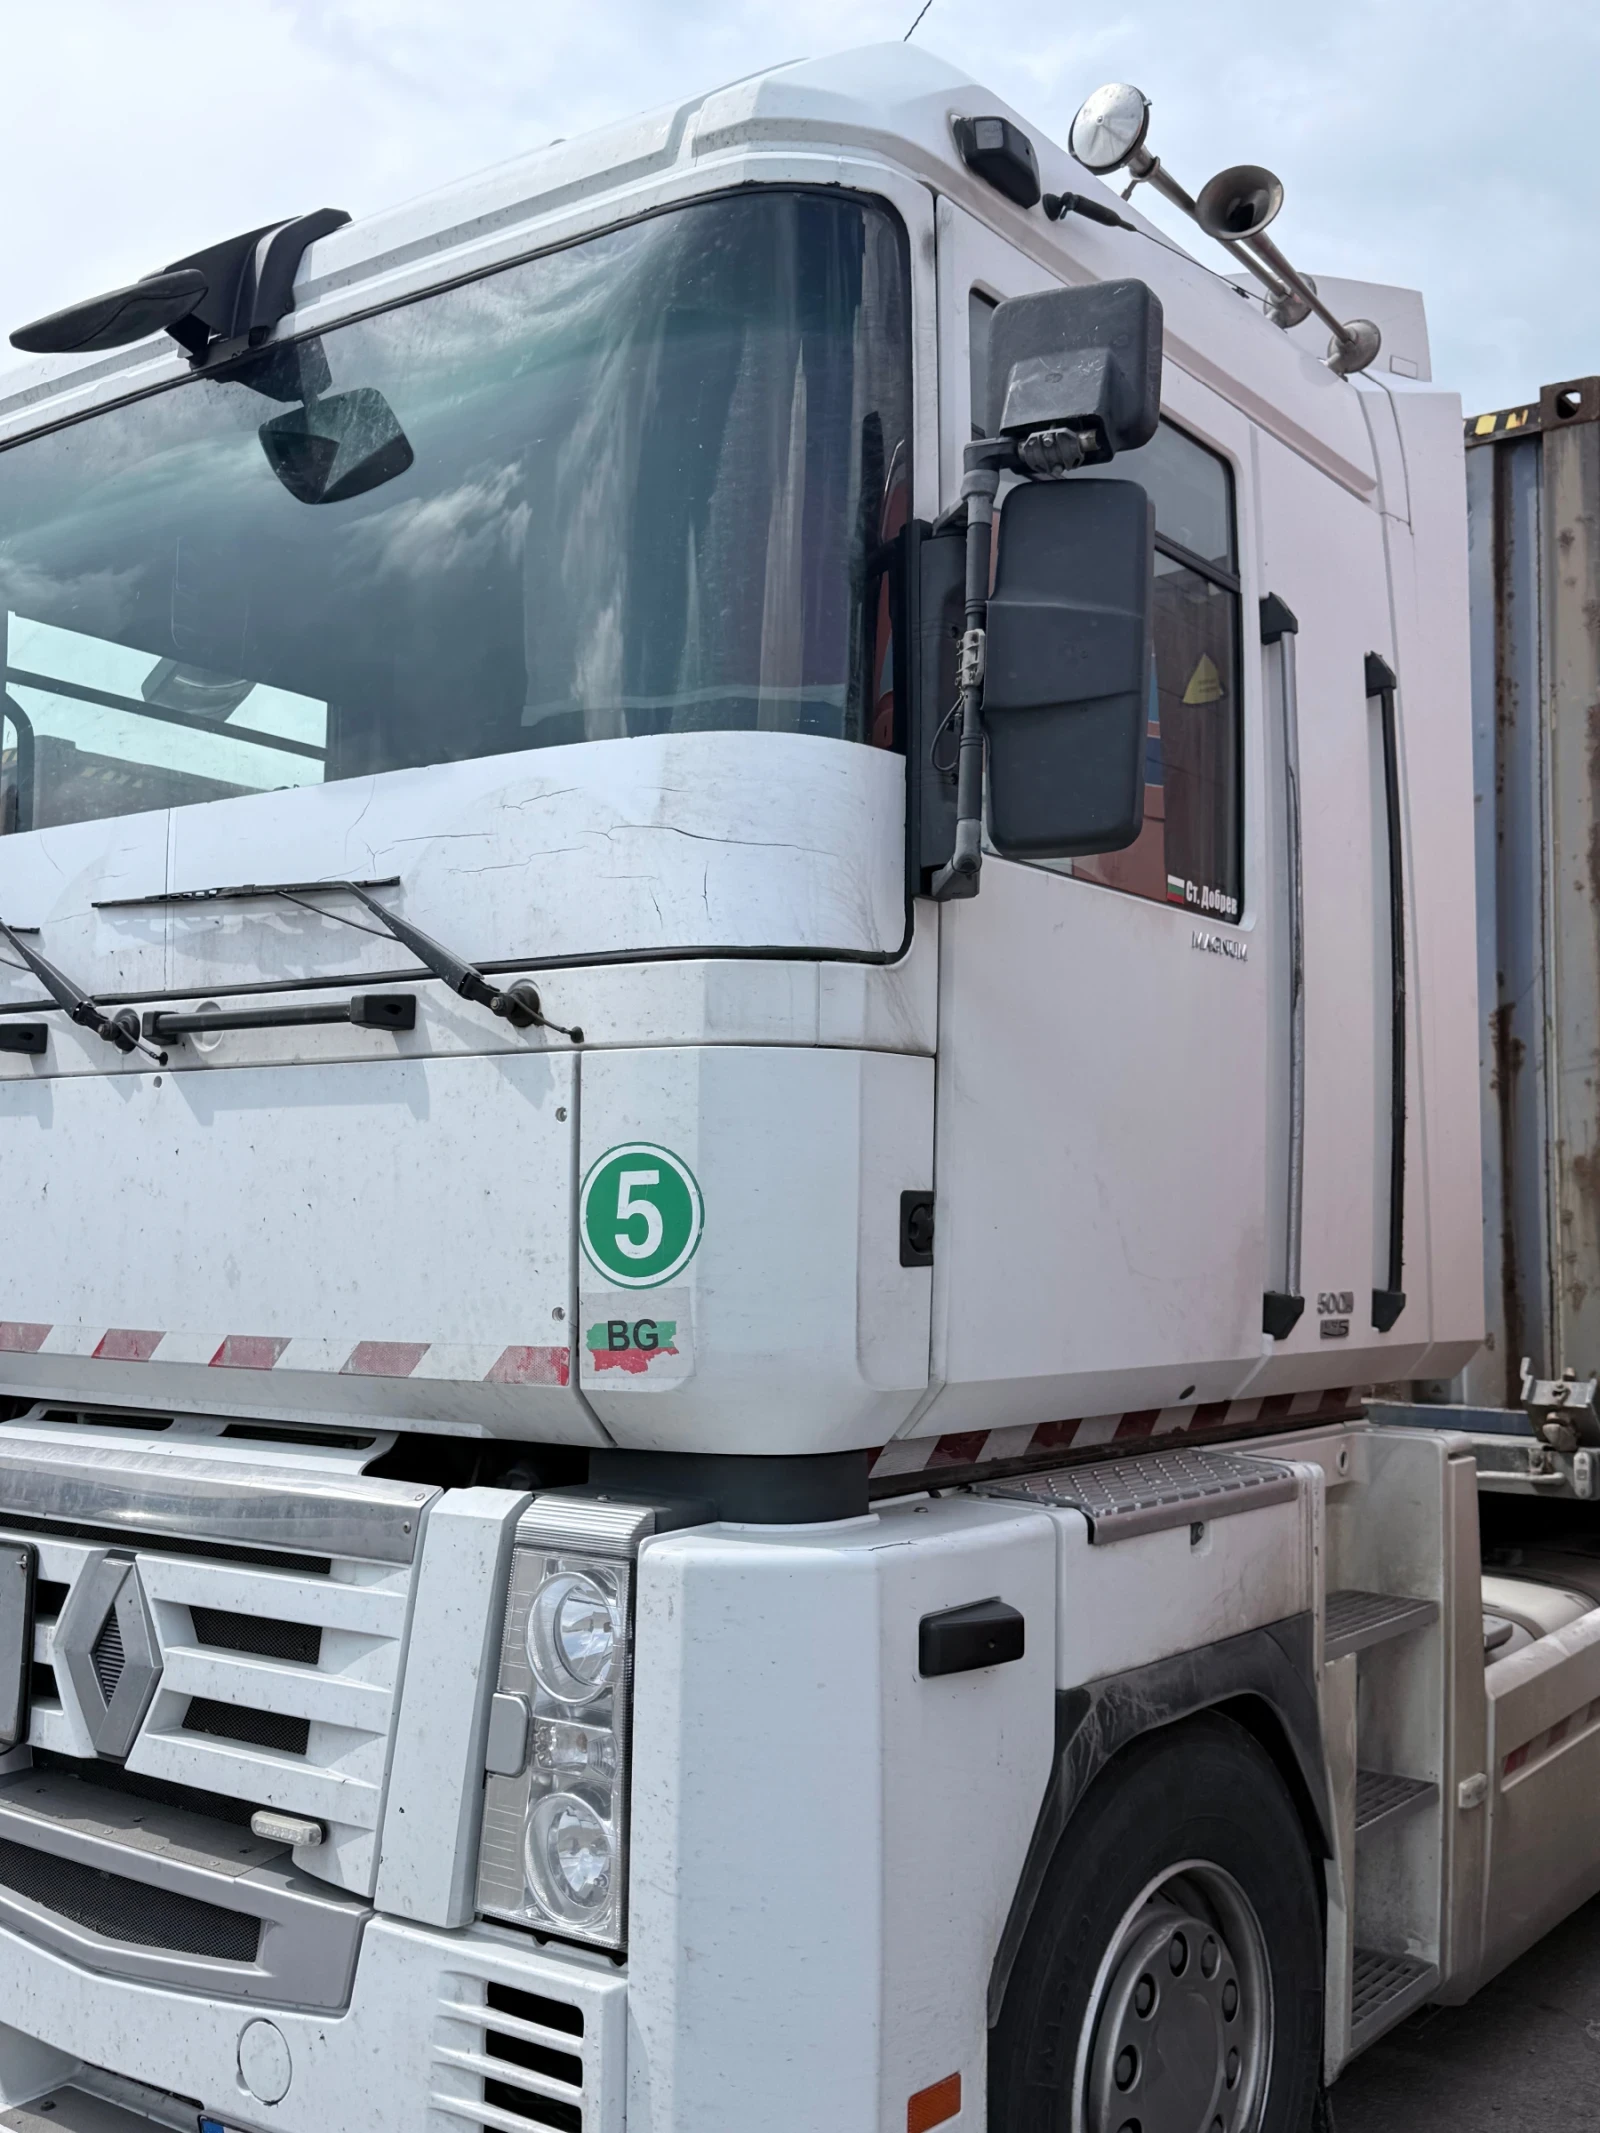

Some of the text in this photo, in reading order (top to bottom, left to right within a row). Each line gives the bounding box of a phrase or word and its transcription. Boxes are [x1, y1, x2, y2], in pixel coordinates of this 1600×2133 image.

[1186, 880, 1238, 915] Ст. Добрев
[614, 1169, 664, 1260] 5
[607, 1318, 660, 1352] BG
